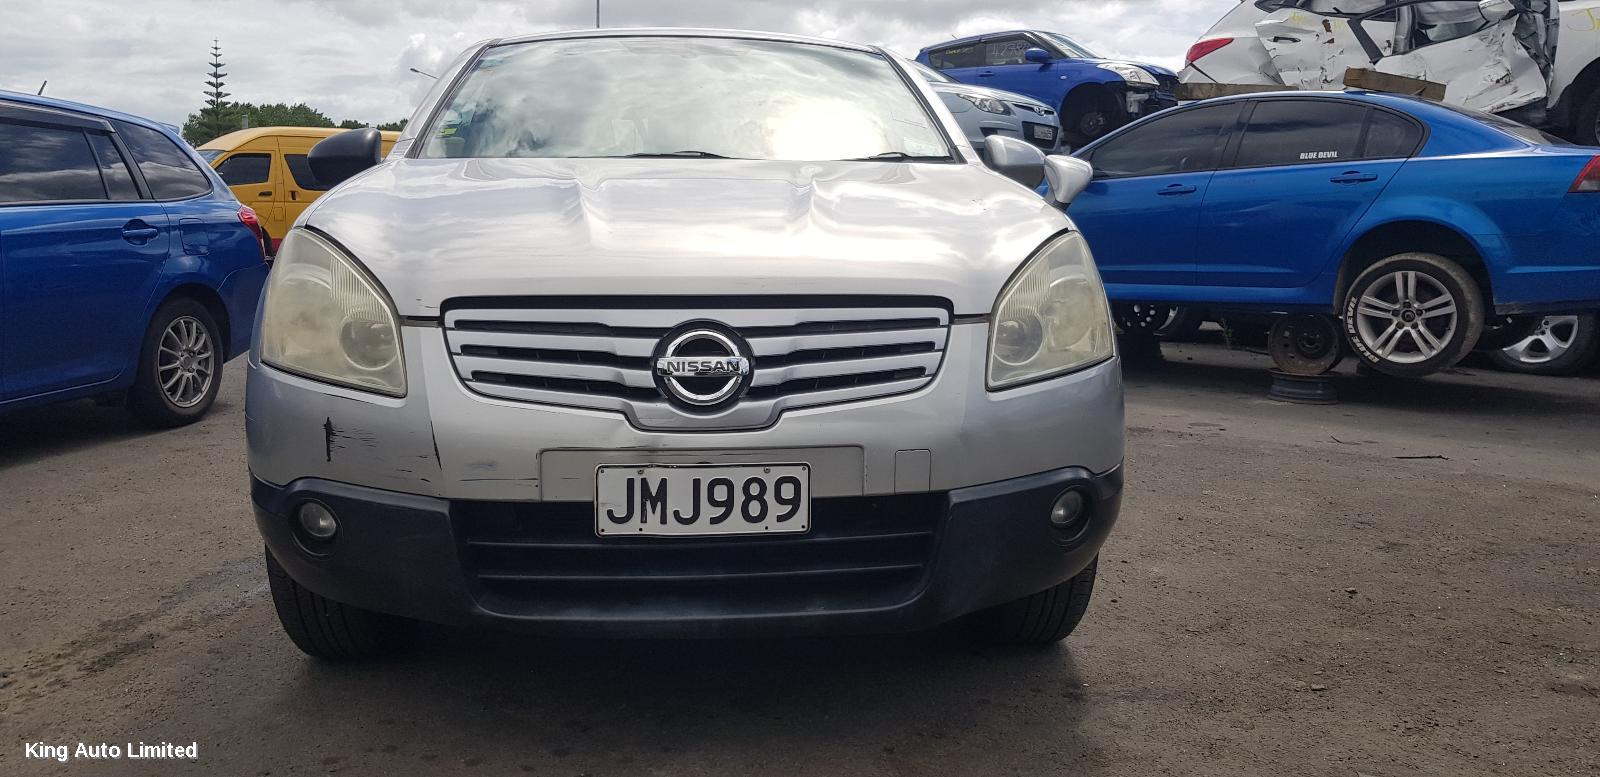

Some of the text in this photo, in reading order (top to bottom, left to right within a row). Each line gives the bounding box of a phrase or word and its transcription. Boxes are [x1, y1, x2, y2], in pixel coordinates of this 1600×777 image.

[1299, 151, 1338, 160] BLUE DEVIL
[1347, 296, 1358, 334] DEVIL
[666, 361, 740, 373] NISSAN
[606, 475, 802, 525] JMJ989
